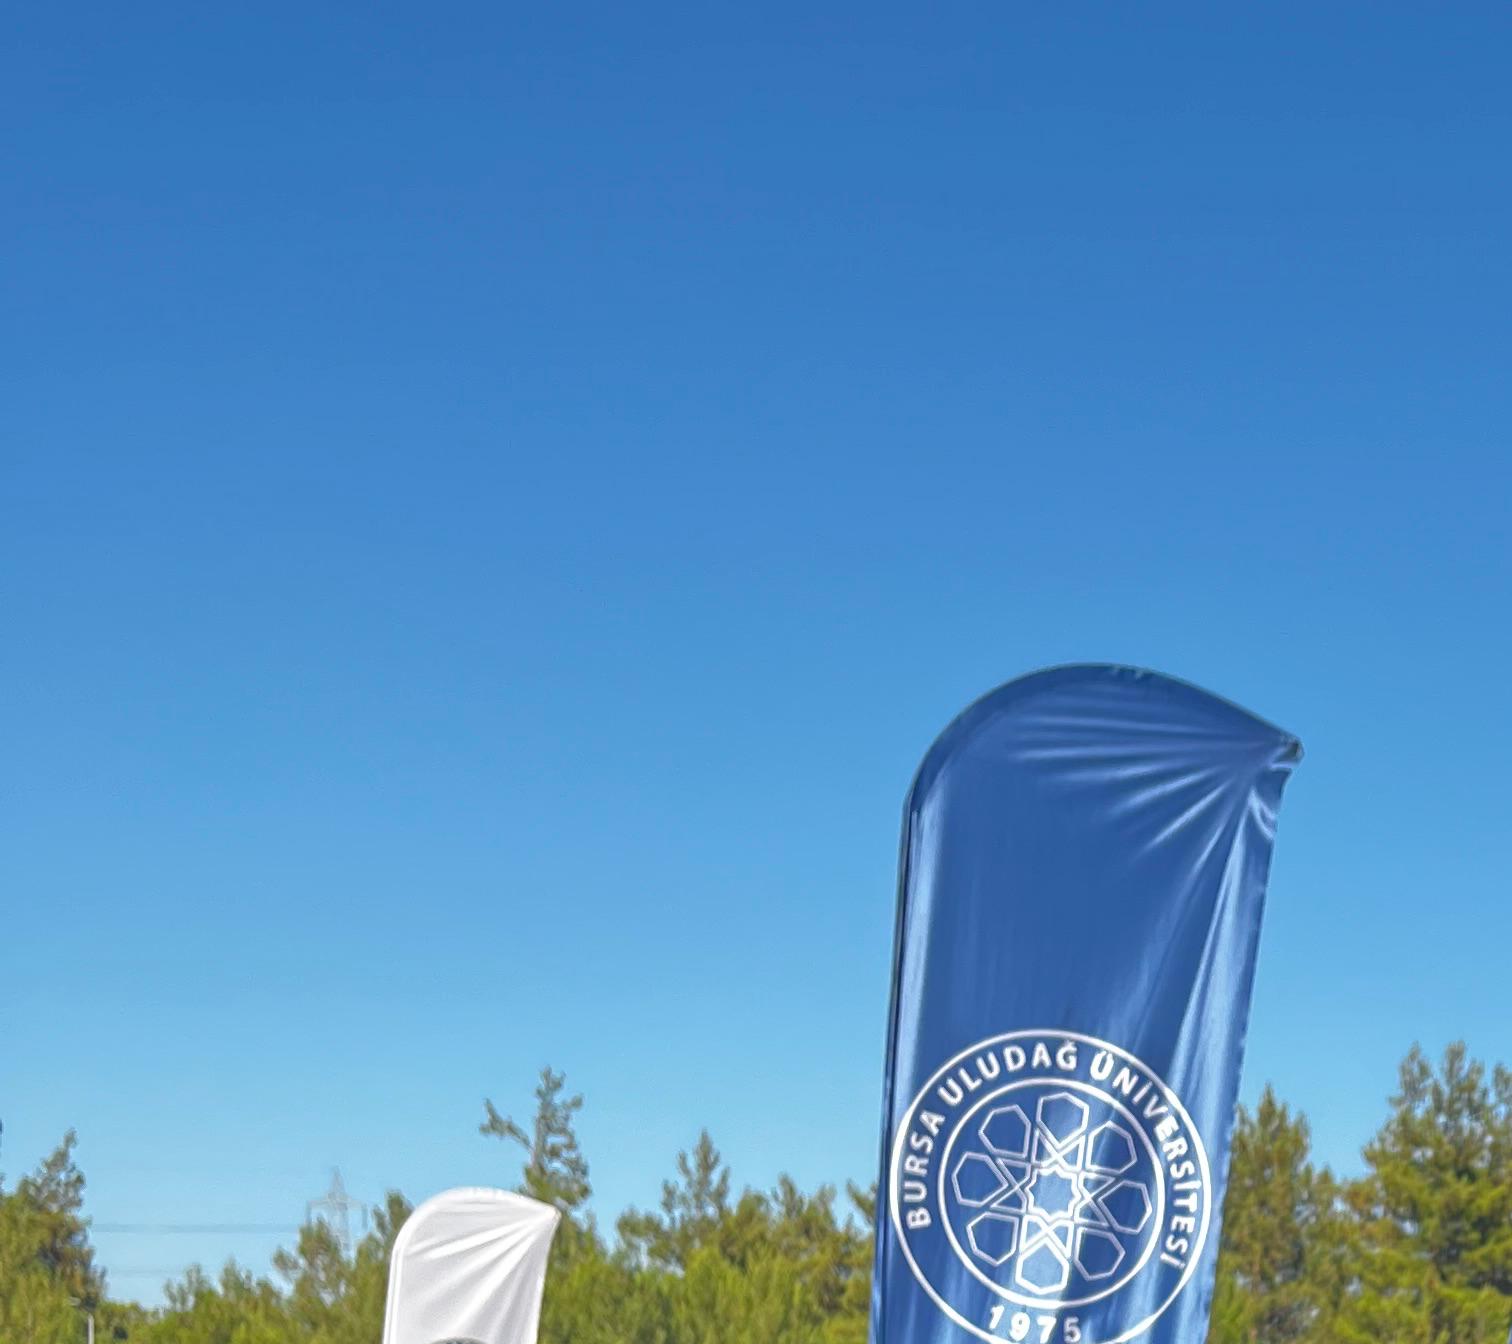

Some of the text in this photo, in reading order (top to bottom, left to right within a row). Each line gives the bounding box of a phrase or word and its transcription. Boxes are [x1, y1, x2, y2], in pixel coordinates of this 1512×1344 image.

[904, 1040, 1202, 1270] BURSA ULUDAĞ ÜNİVERSİTESİ
